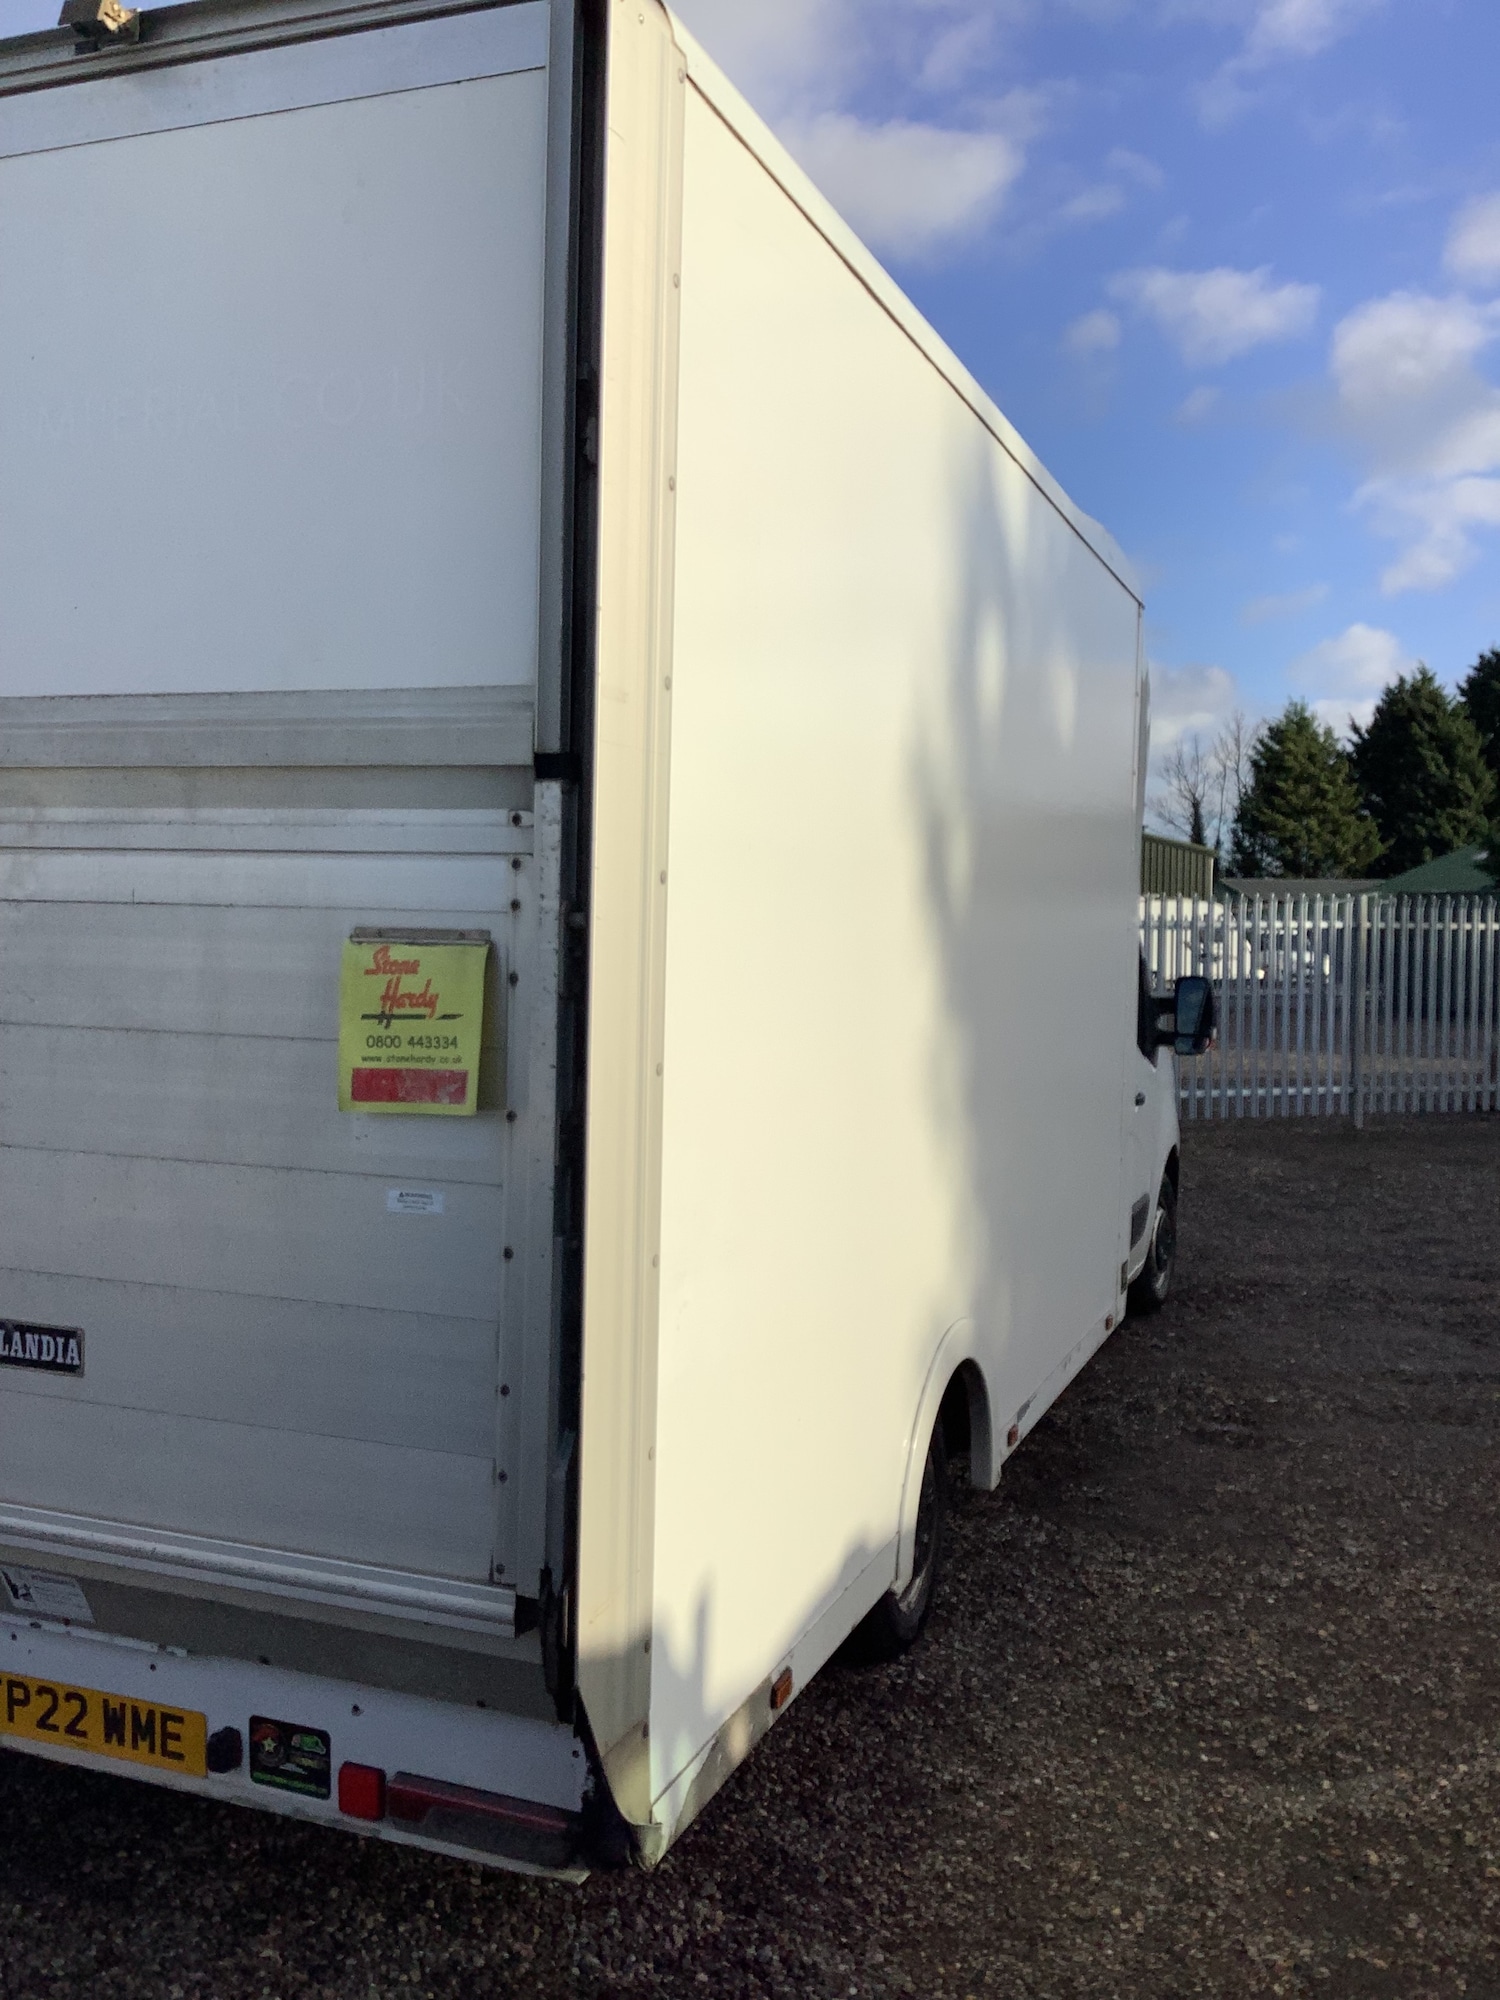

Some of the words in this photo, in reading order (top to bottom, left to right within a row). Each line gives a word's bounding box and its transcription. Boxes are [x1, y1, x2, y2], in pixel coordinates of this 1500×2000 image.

[364, 945, 420, 975] Stone
[380, 976, 439, 1019] Hardy
[366, 1035, 402, 1049] 0800
[407, 1035, 458, 1049] 443334
[0, 1678, 88, 1738] P22
[102, 1698, 186, 1761] WME
